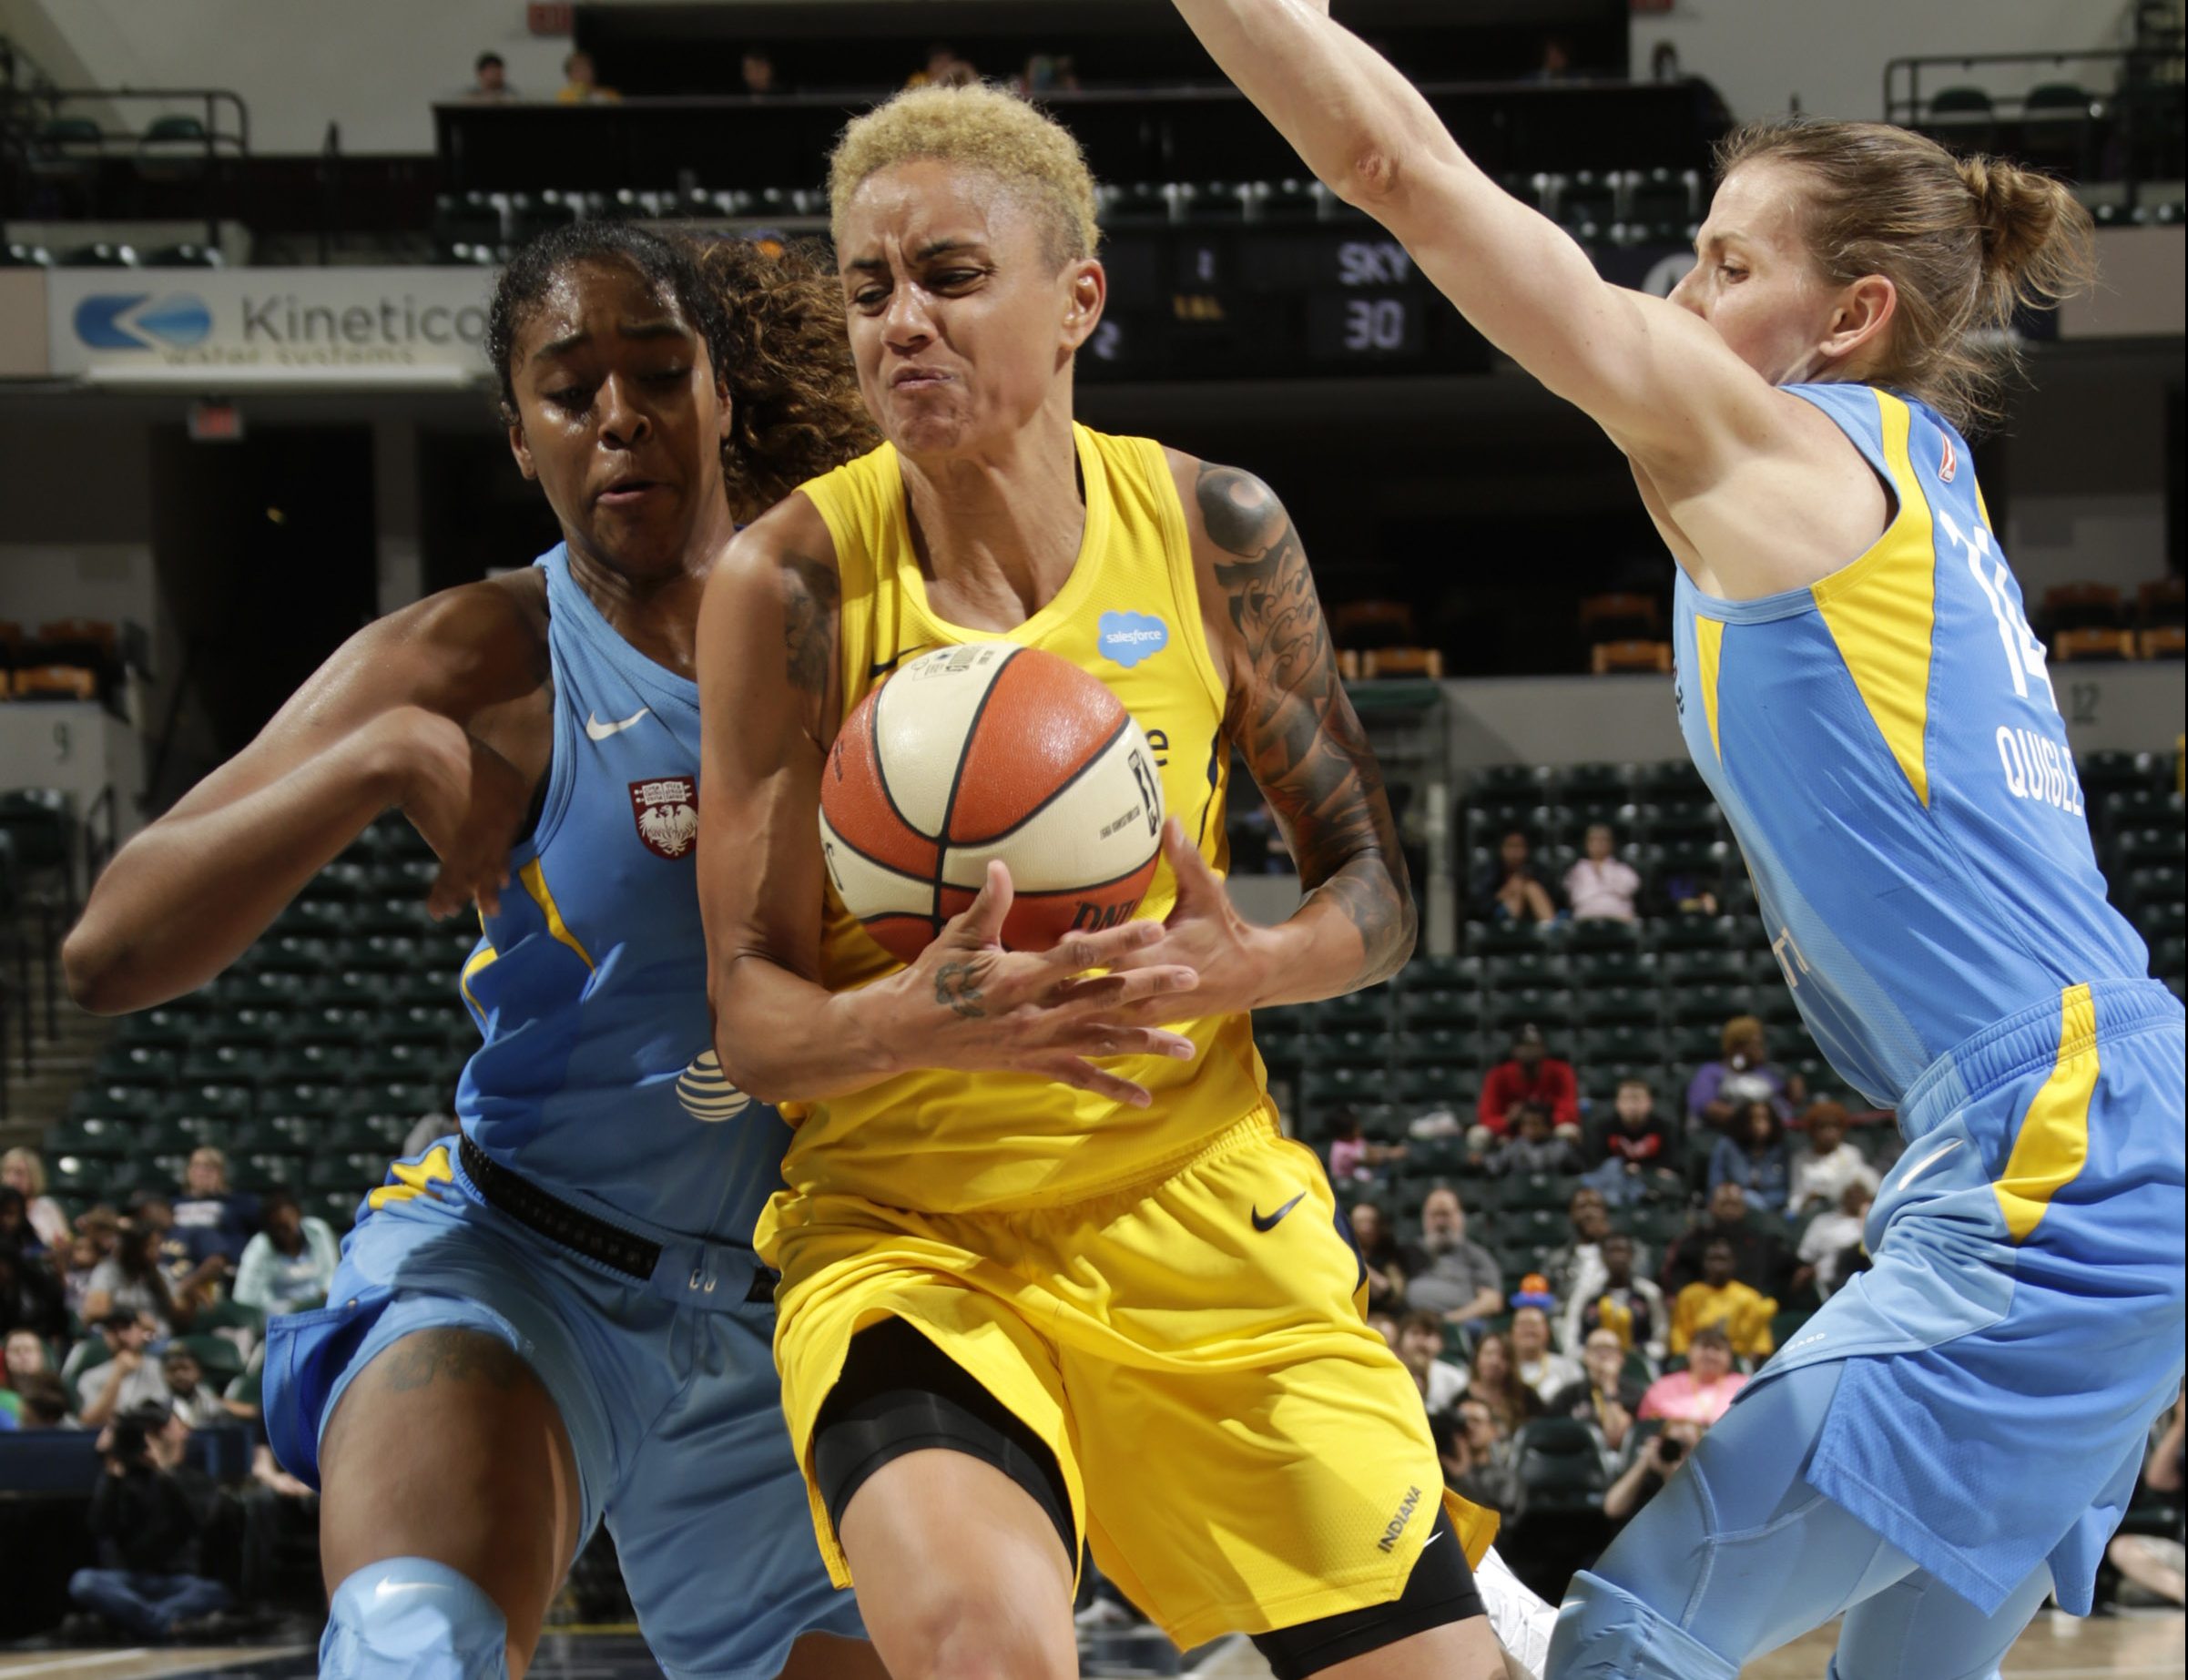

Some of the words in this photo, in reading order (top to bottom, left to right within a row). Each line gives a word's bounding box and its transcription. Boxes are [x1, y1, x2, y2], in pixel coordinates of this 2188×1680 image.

[1338, 241, 1409, 284] SKY
[241, 294, 489, 345] Kinetico
[1346, 300, 1404, 349] 30
[1939, 508, 2060, 712] 14
[1106, 629, 1161, 645] salesforce
[2071, 683, 2100, 725] 12
[1377, 1485, 1422, 1553] INDIANA
